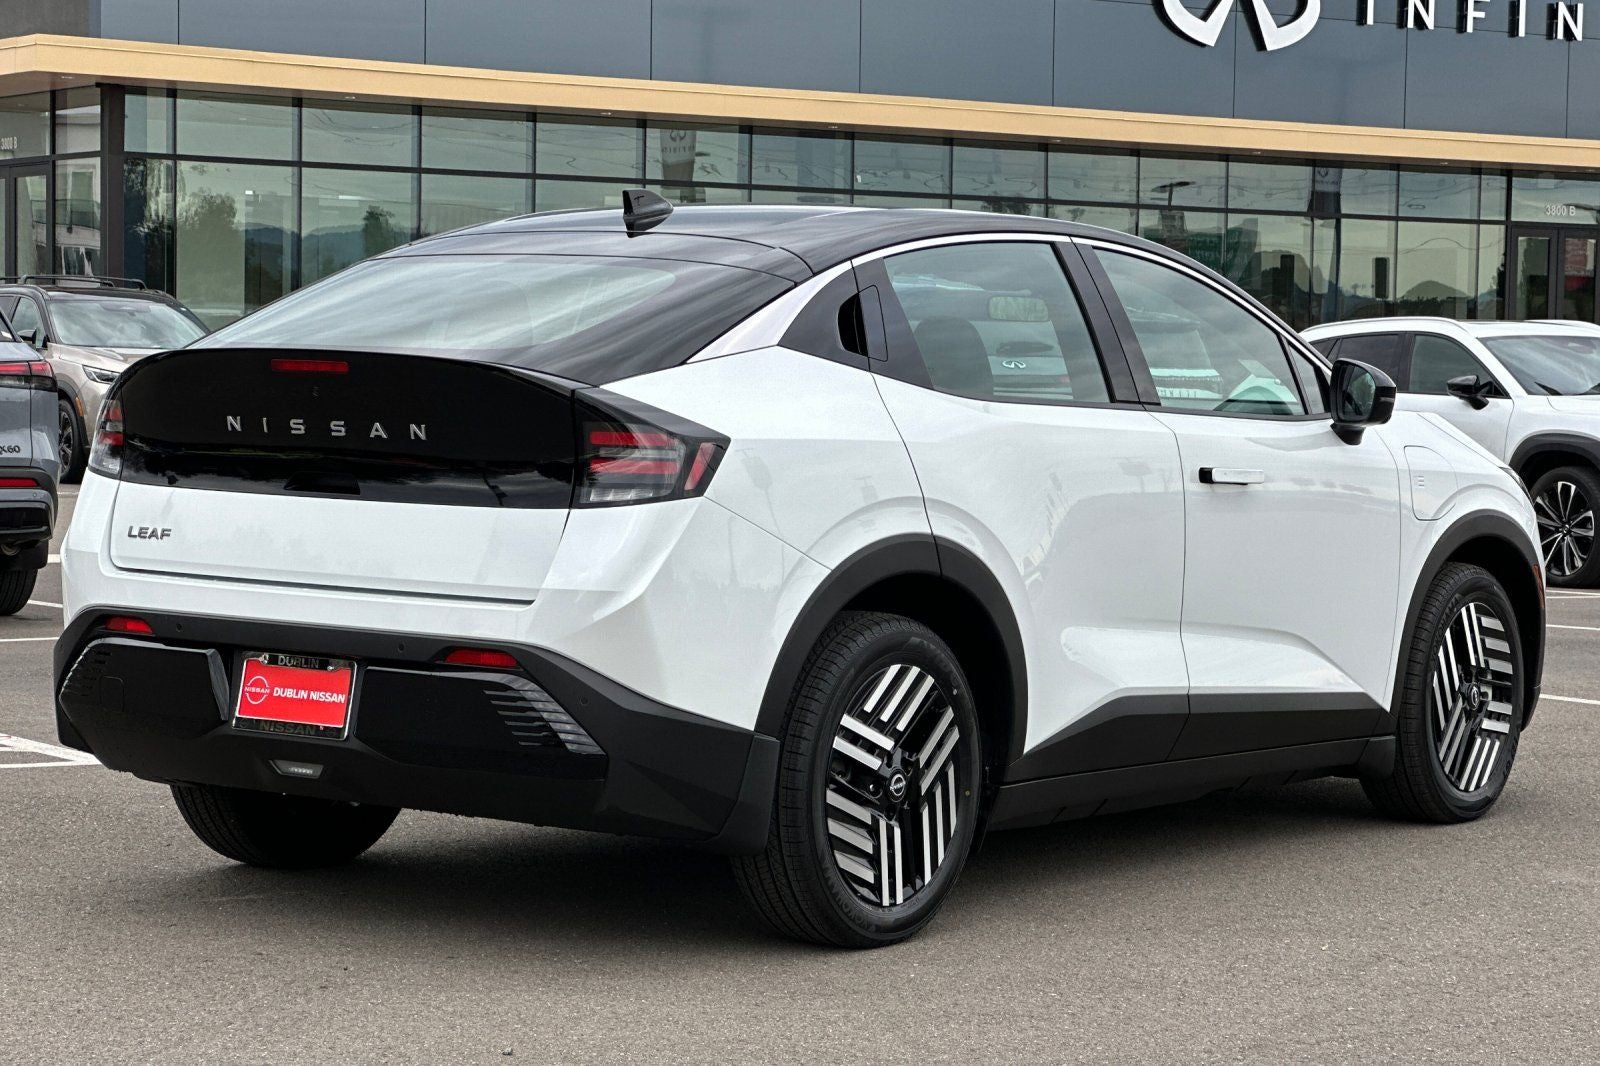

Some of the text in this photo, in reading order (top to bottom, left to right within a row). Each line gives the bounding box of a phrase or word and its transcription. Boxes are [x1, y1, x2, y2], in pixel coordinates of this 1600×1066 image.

[1545, 203, 1576, 217] 3800 B
[226, 415, 427, 441] NISSAN
[127, 526, 172, 540] LEAF
[277, 655, 320, 669] DUBLIN
[244, 686, 270, 694] NISSAN
[273, 687, 346, 704] DUBLIN NISSAN
[259, 720, 317, 735] NISSAN
